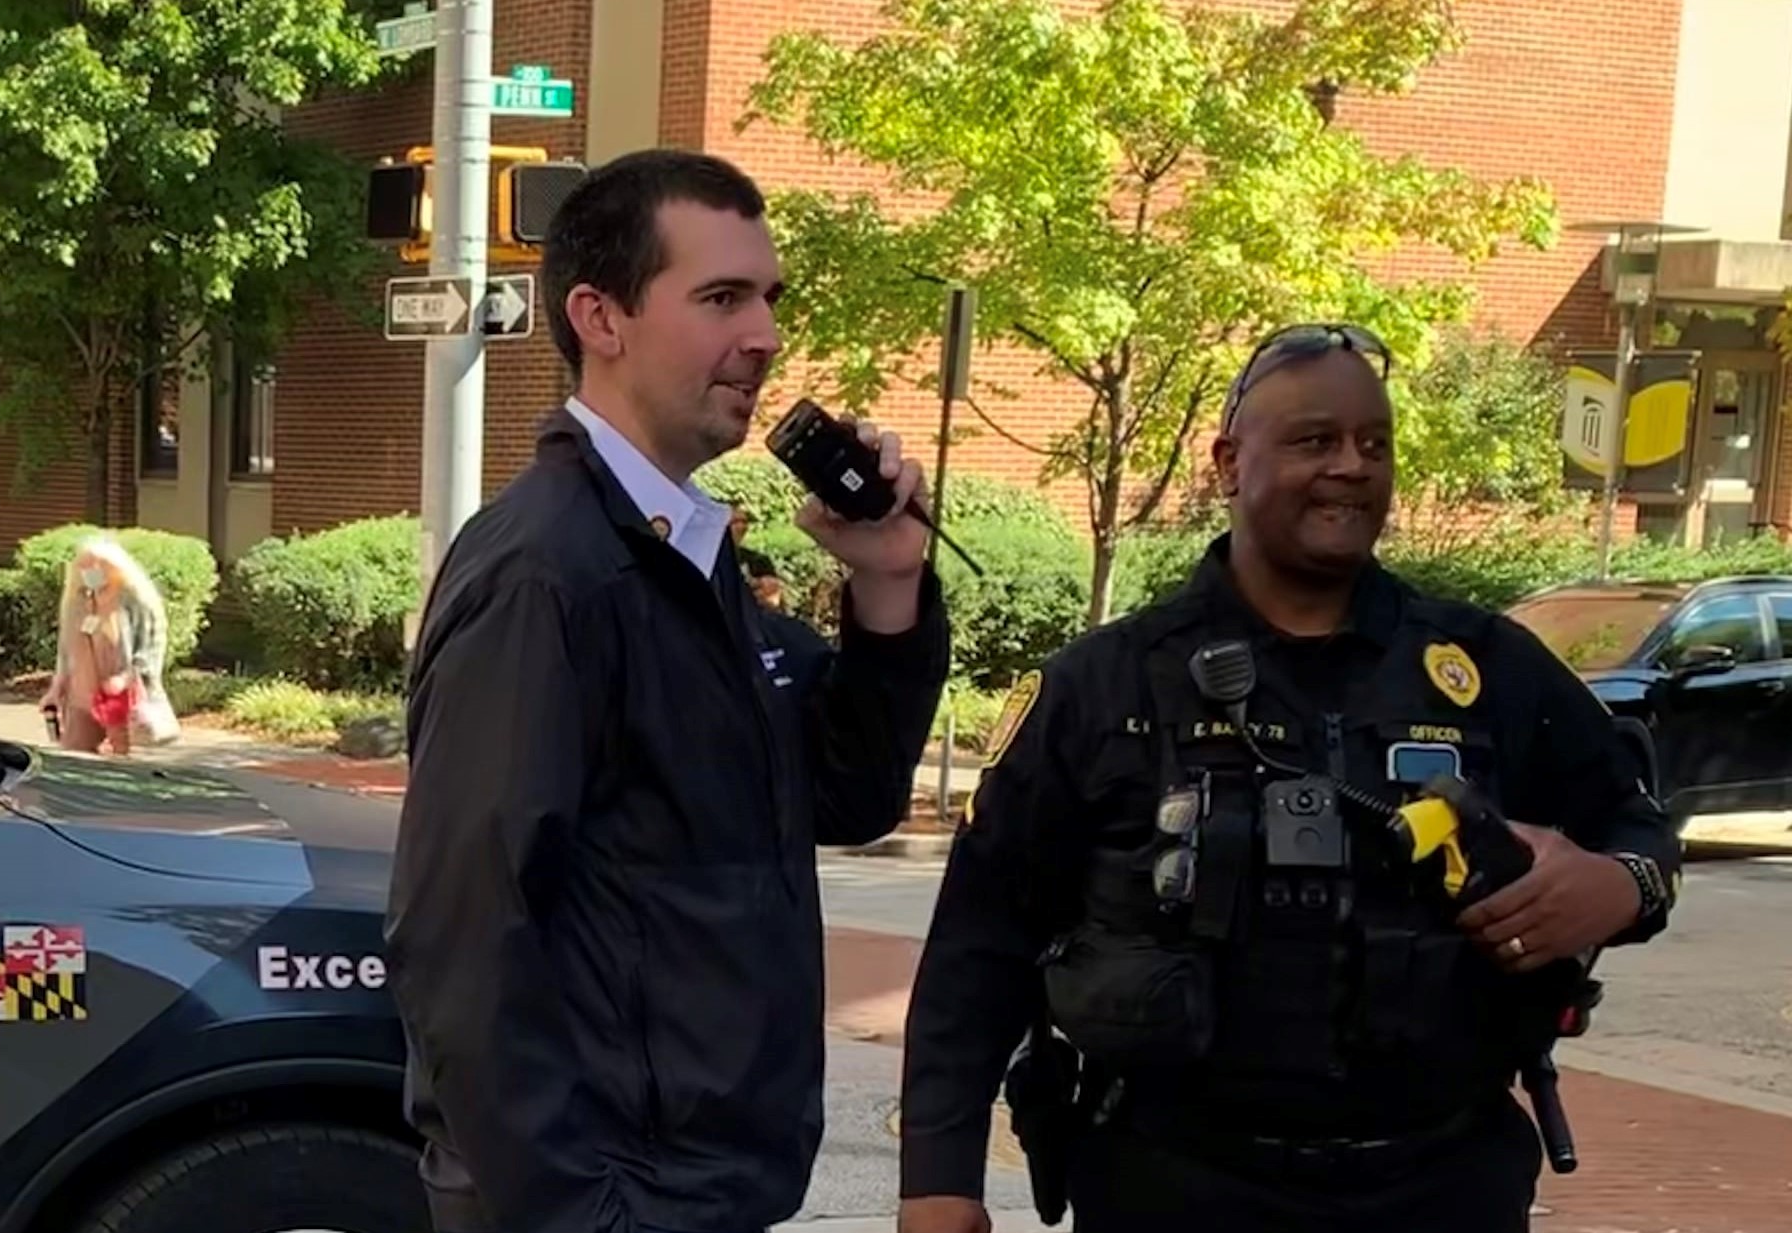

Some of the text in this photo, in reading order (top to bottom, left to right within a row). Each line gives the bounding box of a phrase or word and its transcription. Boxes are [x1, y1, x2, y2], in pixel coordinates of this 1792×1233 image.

[396, 296, 446, 319] ONE WAY
[1409, 724, 1463, 742] OFFICER
